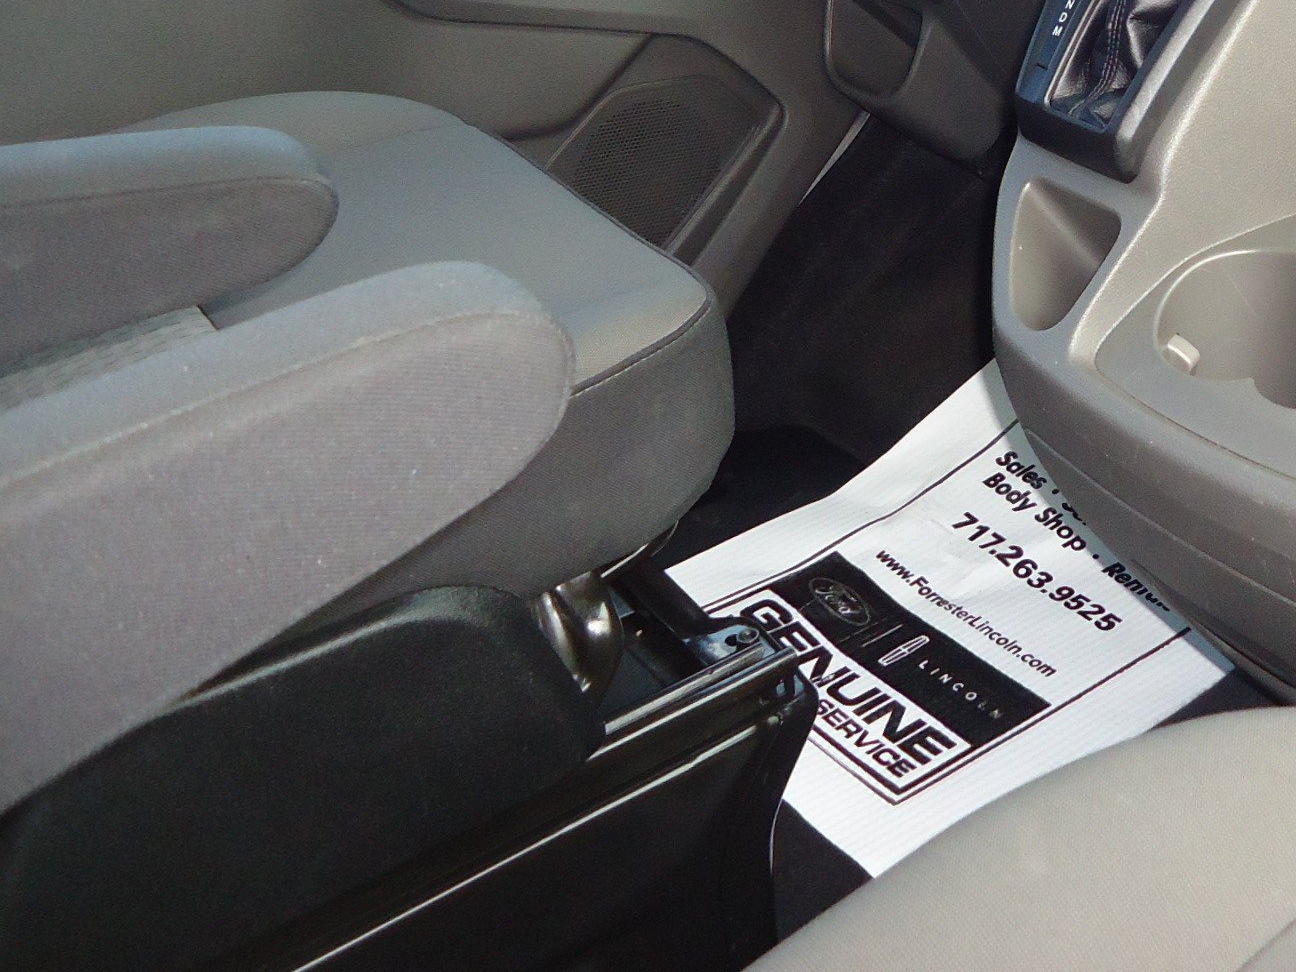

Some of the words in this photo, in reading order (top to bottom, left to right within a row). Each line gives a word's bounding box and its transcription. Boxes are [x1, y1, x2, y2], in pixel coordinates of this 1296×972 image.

[1051, 25, 1063, 37] M
[1058, 11, 1068, 23] D
[995, 450, 1047, 490] Sales
[982, 472, 1037, 512] Body
[1034, 506, 1087, 552] Shop
[951, 511, 1123, 631] 717.263.9525
[875, 549, 1058, 678] www.ForresterLincoln.com
[739, 598, 958, 767] GENUINE
[918, 659, 1002, 720] LINCOLN
[817, 698, 918, 779] SERVICE
